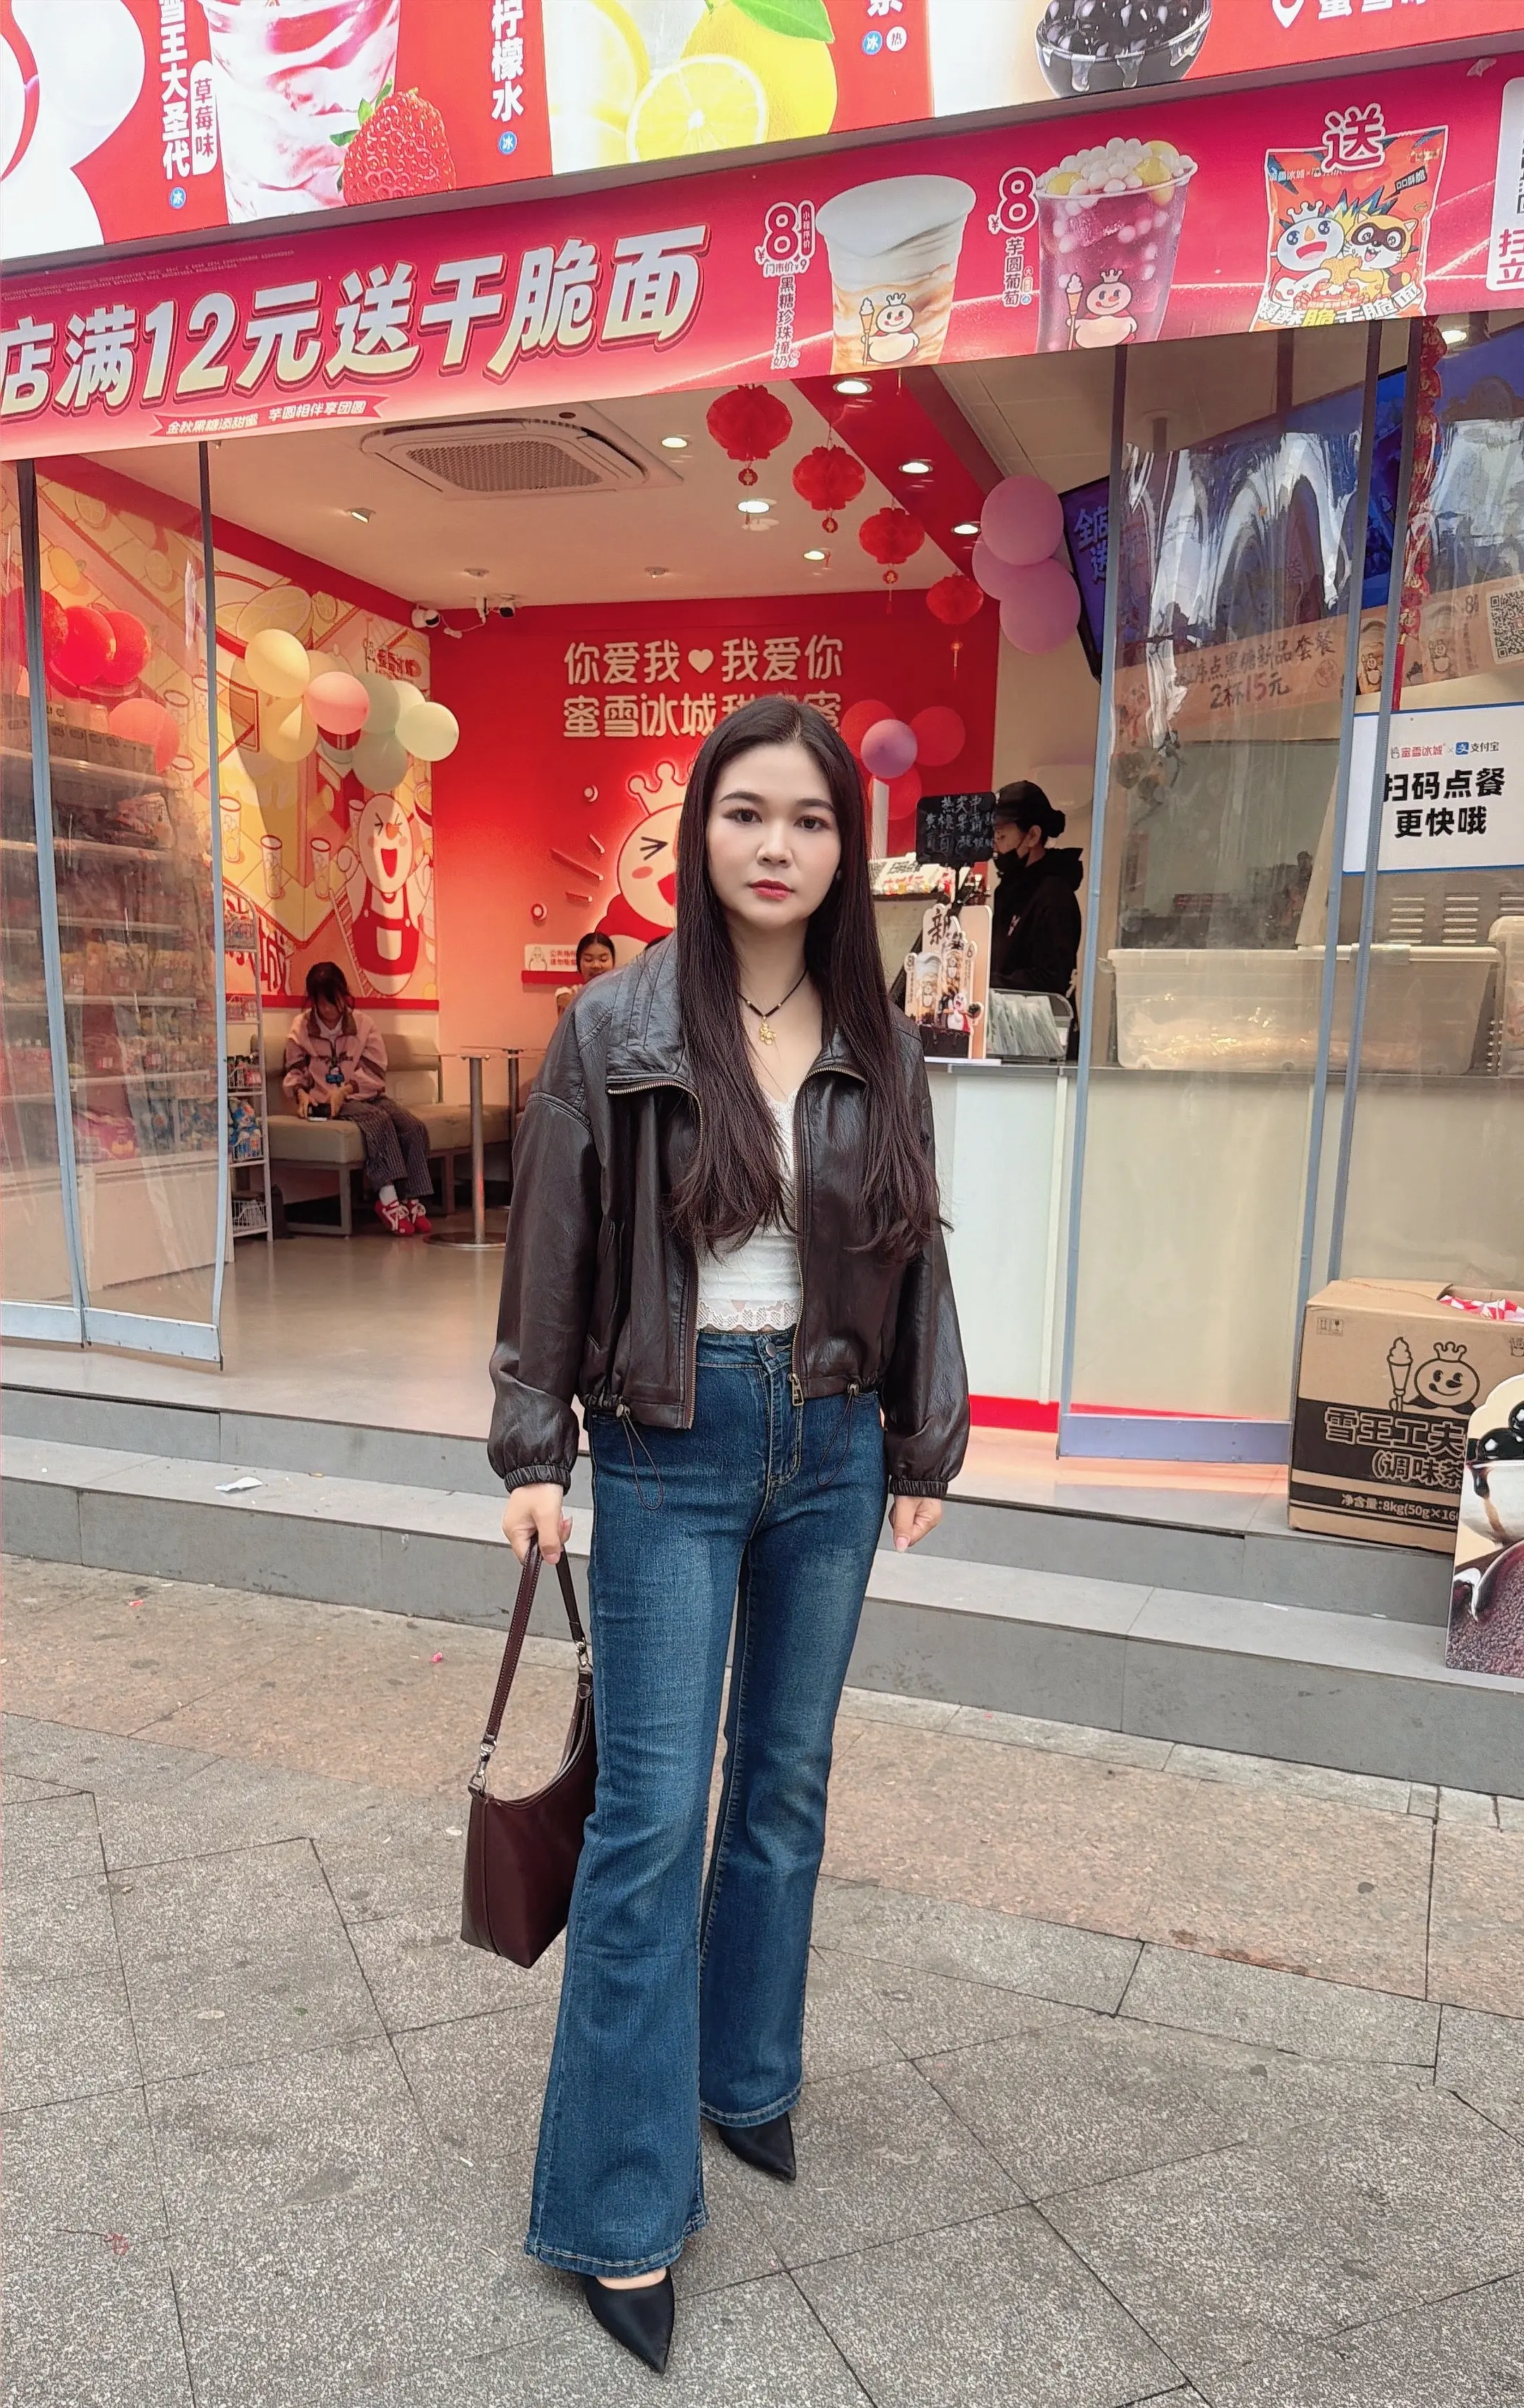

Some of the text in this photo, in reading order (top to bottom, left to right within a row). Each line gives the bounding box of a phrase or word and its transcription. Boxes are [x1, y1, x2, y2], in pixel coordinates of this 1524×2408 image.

[491, 0, 525, 123] 柠檬水
[194, 77, 214, 158] 草莓味
[1324, 105, 1384, 170] 送
[1004, 238, 1024, 305] 芋圆葡萄
[0, 224, 711, 418] 店满12元送干脆面
[773, 276, 795, 367] 黑糖珍珠撞奶
[267, 400, 367, 422] 芋圆相伴享团圆
[564, 635, 843, 686] 你爱我 我爱你
[1210, 671, 1290, 710] 2杯15元
[1401, 744, 1444, 758] 蜜雪冰城
[1470, 741, 1500, 753] 支付宝
[1383, 767, 1506, 802] 扫码点餐
[1394, 805, 1487, 839] 更快哦
[1324, 1406, 1465, 1459] 雪王工夫
[1341, 1493, 1458, 1522] 净含量:8kg(50g×16
